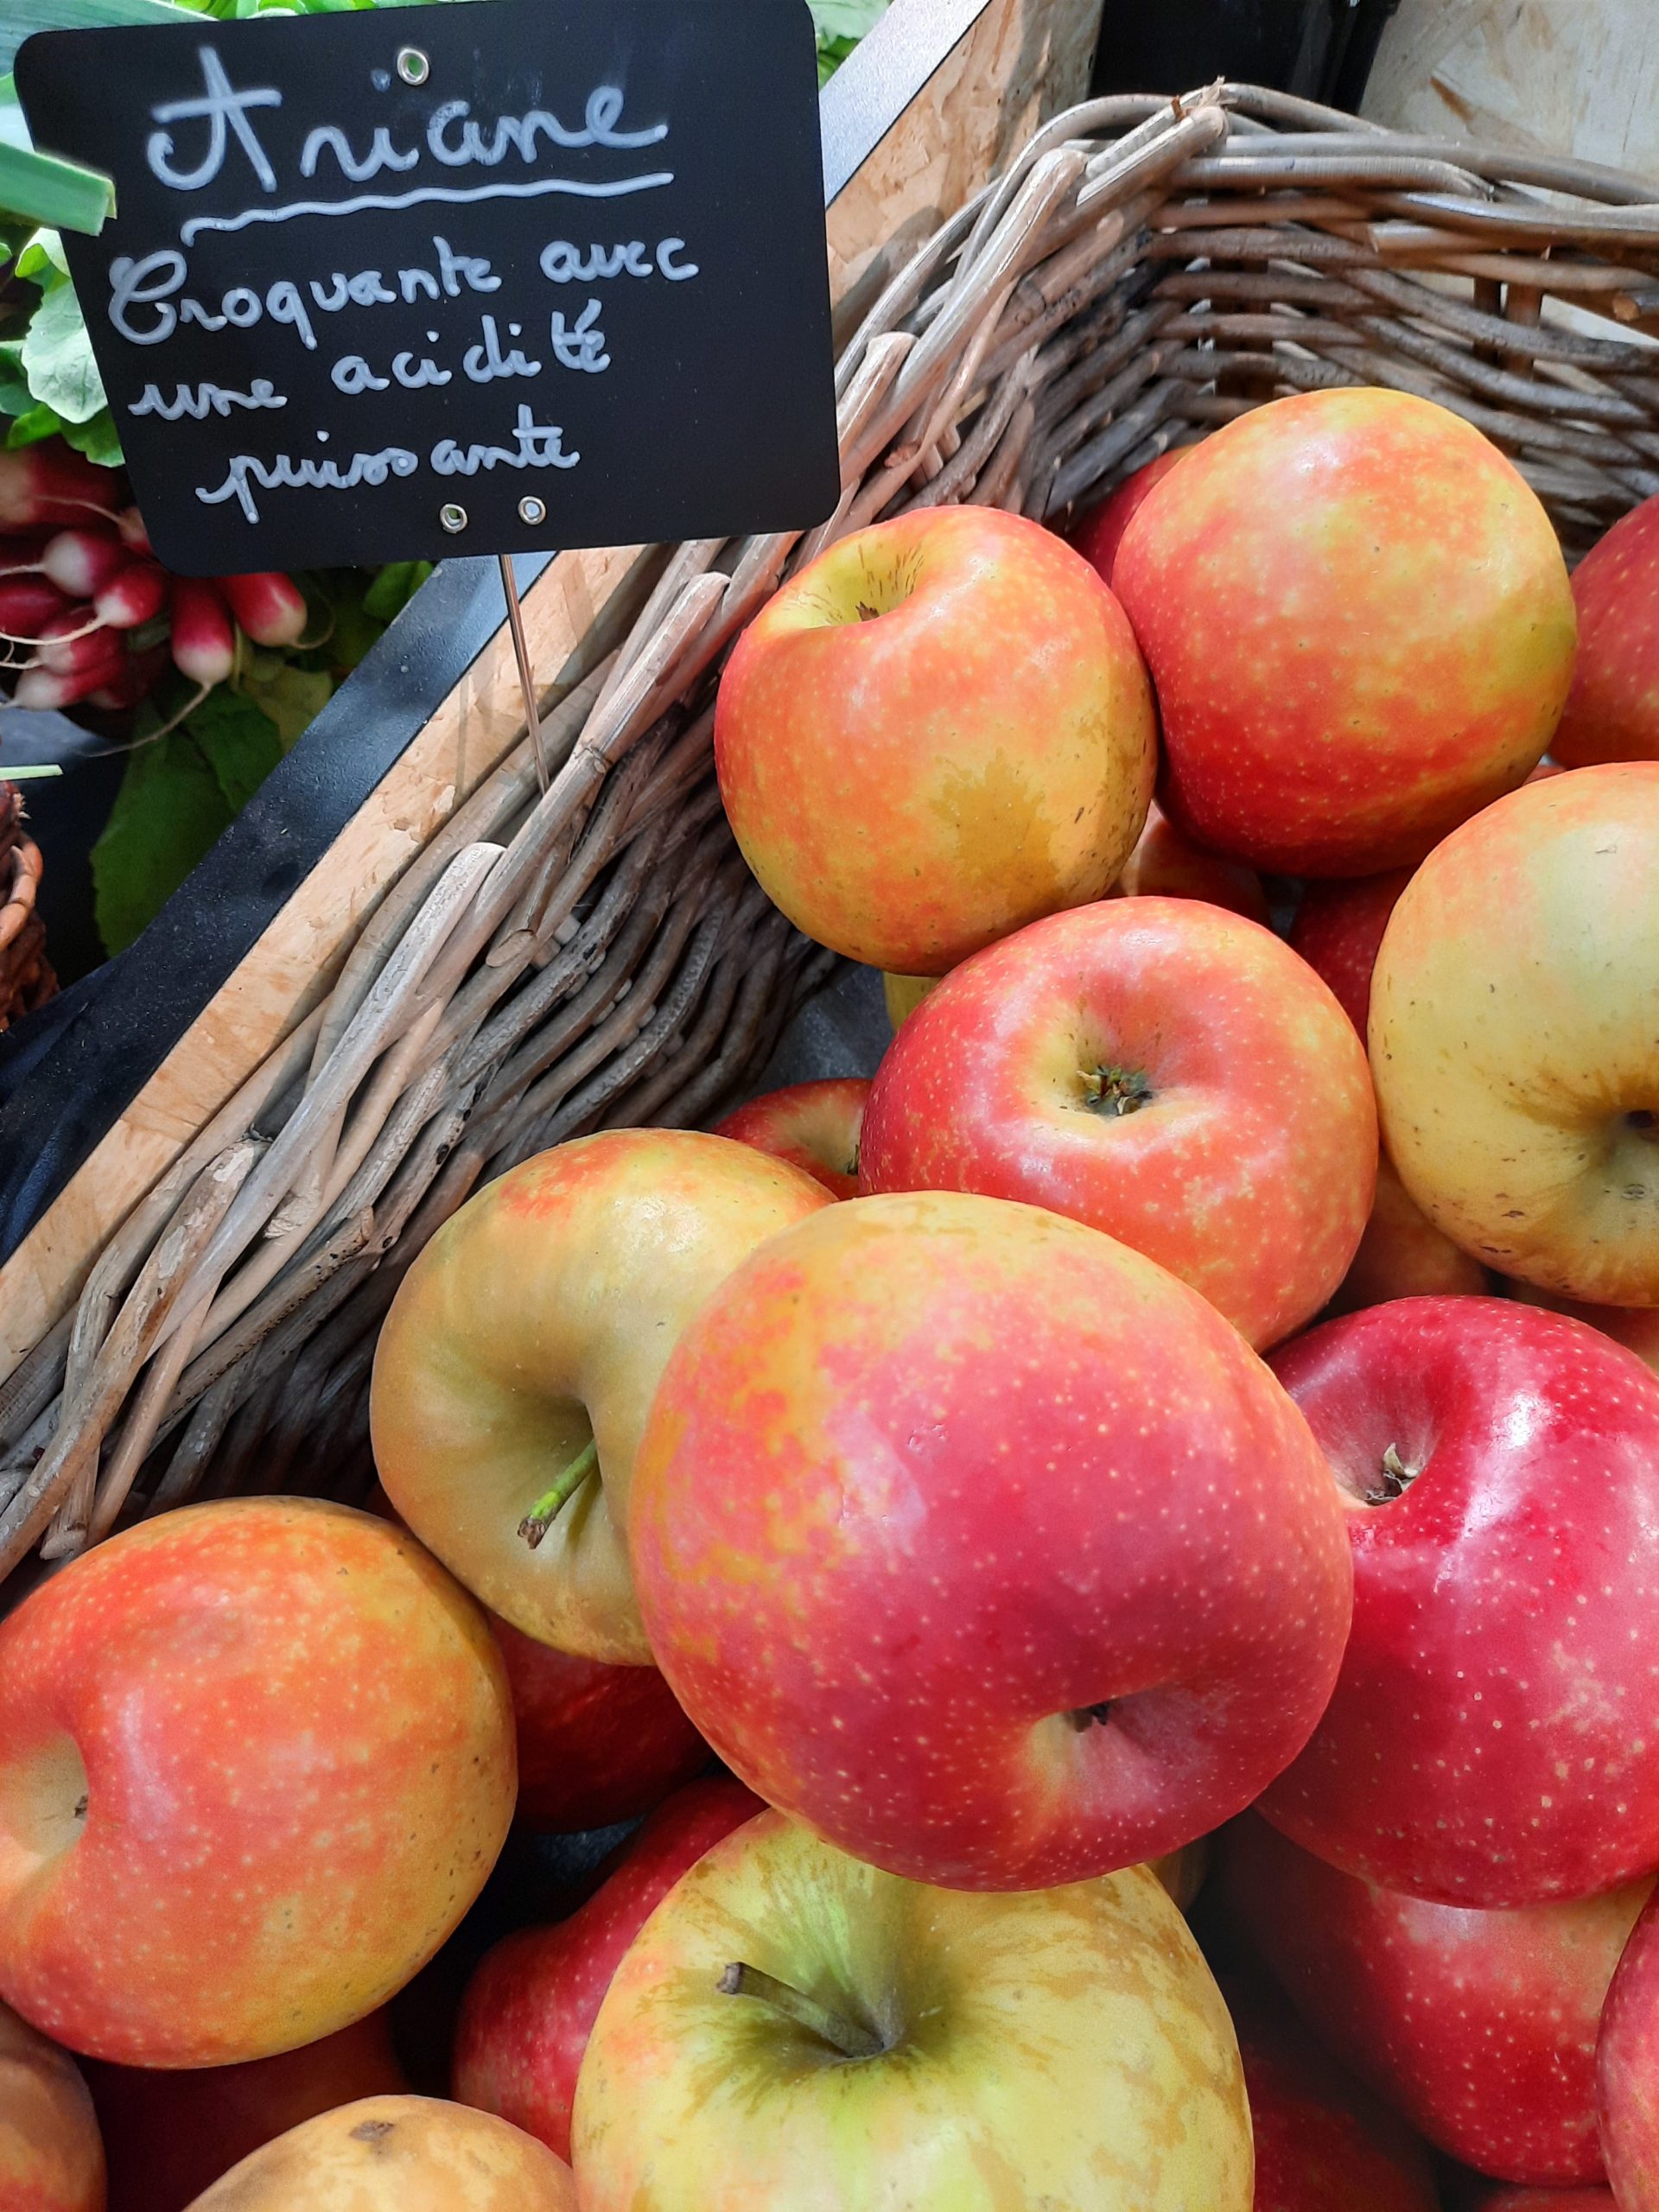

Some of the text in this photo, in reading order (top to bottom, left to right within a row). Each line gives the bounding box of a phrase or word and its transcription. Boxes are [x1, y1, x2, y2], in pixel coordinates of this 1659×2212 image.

[147, 45, 669, 192] Ariane
[108, 235, 699, 348] Croquante avec
[128, 299, 612, 421] une acidité
[195, 404, 581, 524] puissante
